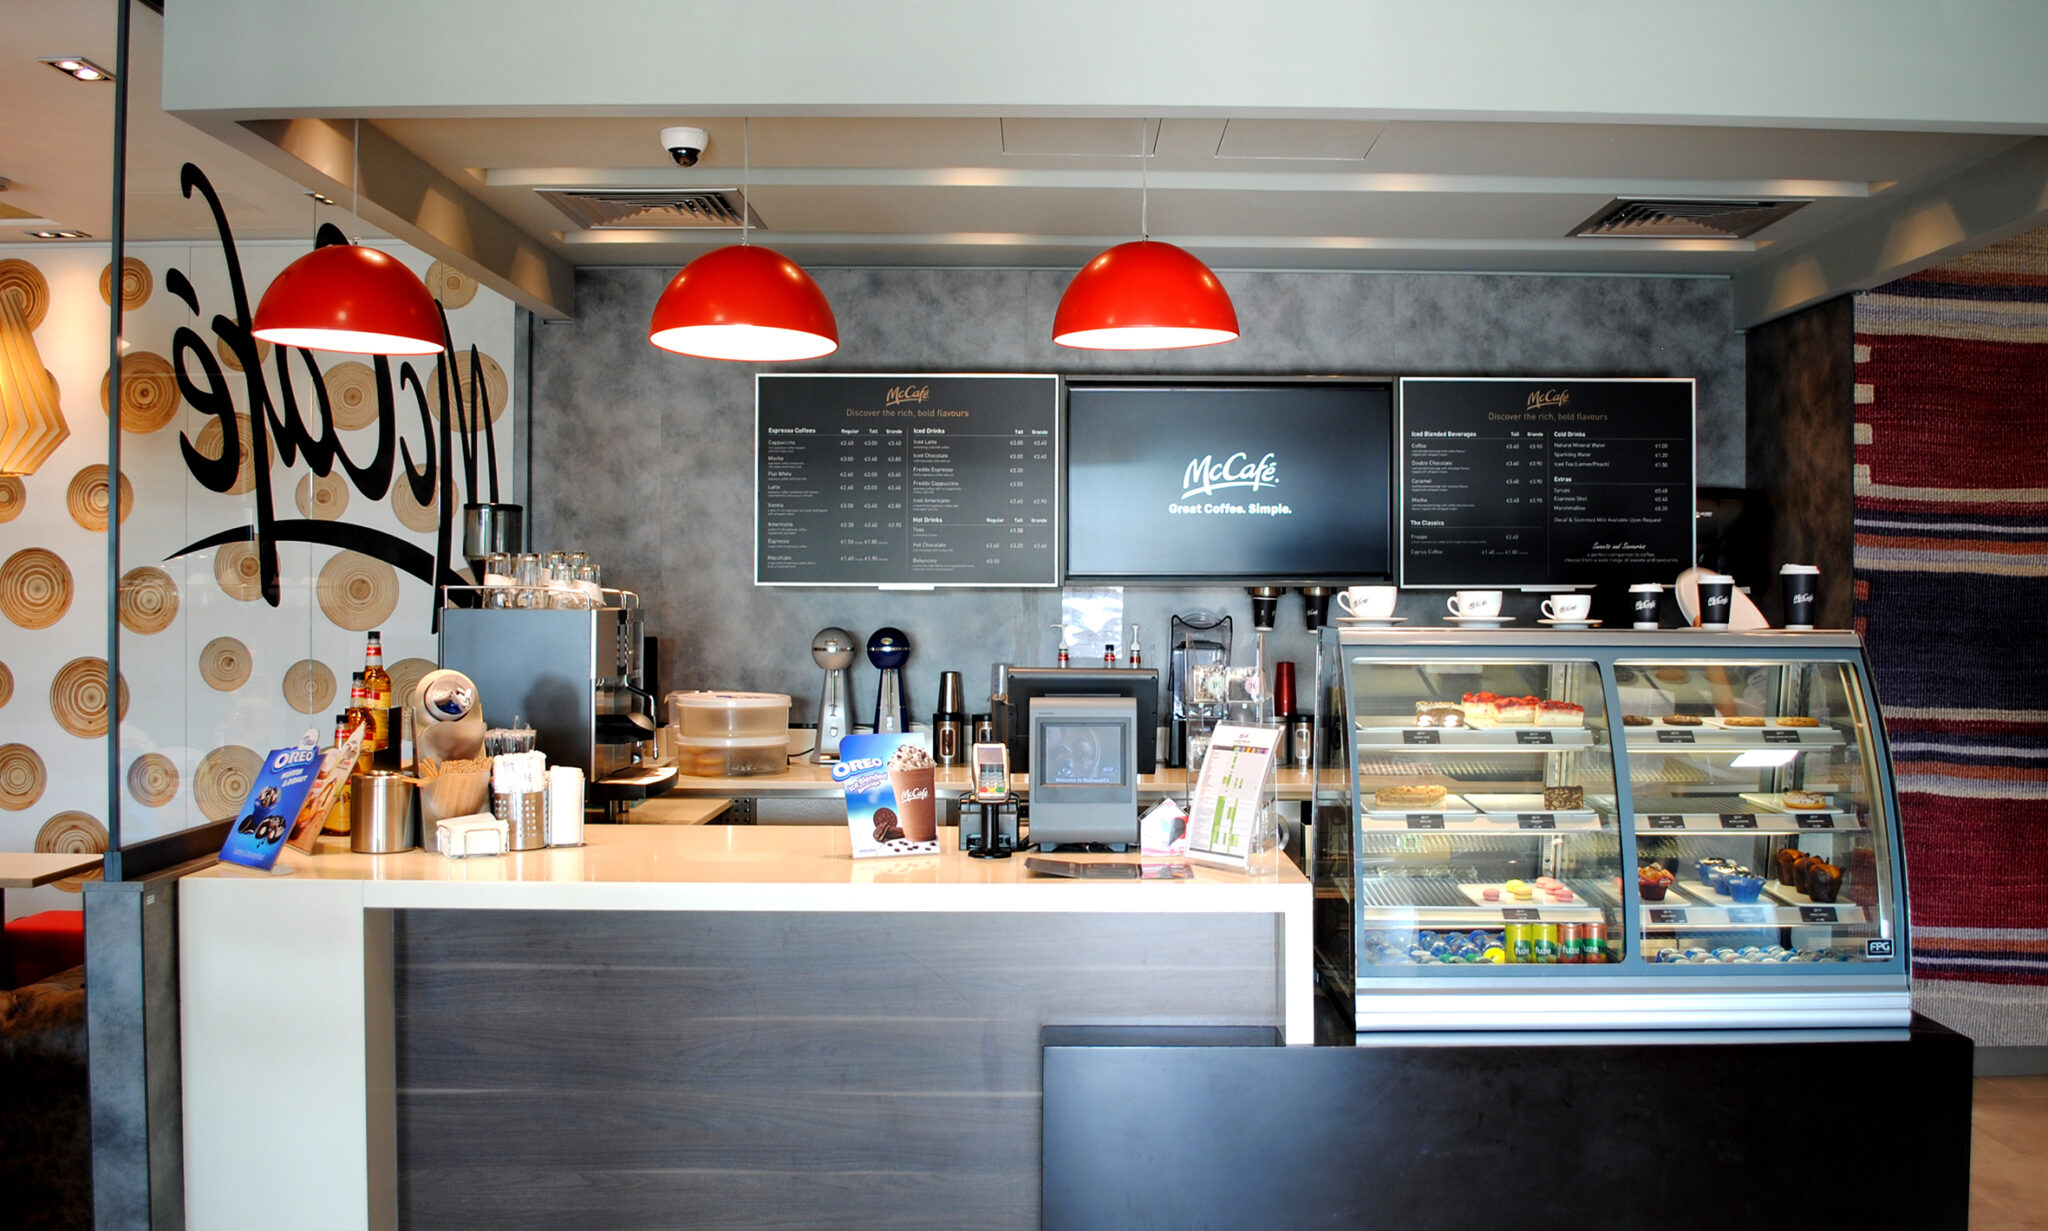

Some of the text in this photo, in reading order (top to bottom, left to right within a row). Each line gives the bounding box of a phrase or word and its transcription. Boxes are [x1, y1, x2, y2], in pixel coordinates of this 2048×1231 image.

[885, 385, 931, 406] McCafé
[1527, 389, 1570, 410] McCafé
[846, 408, 969, 417] Discover the rich, bold flavours
[1488, 412, 1608, 421] Discover the rich, bold flavours
[1168, 503, 1292, 516] Great Coffee. Simple.
[274, 751, 314, 769] OREO
[832, 758, 882, 777] OREO
[848, 772, 888, 792] Ice Blended
[901, 788, 928, 804] McCafé
[1535, 946, 1551, 954] fuze
[1563, 945, 1580, 954] fuze
[1869, 941, 1890, 950] FPG
